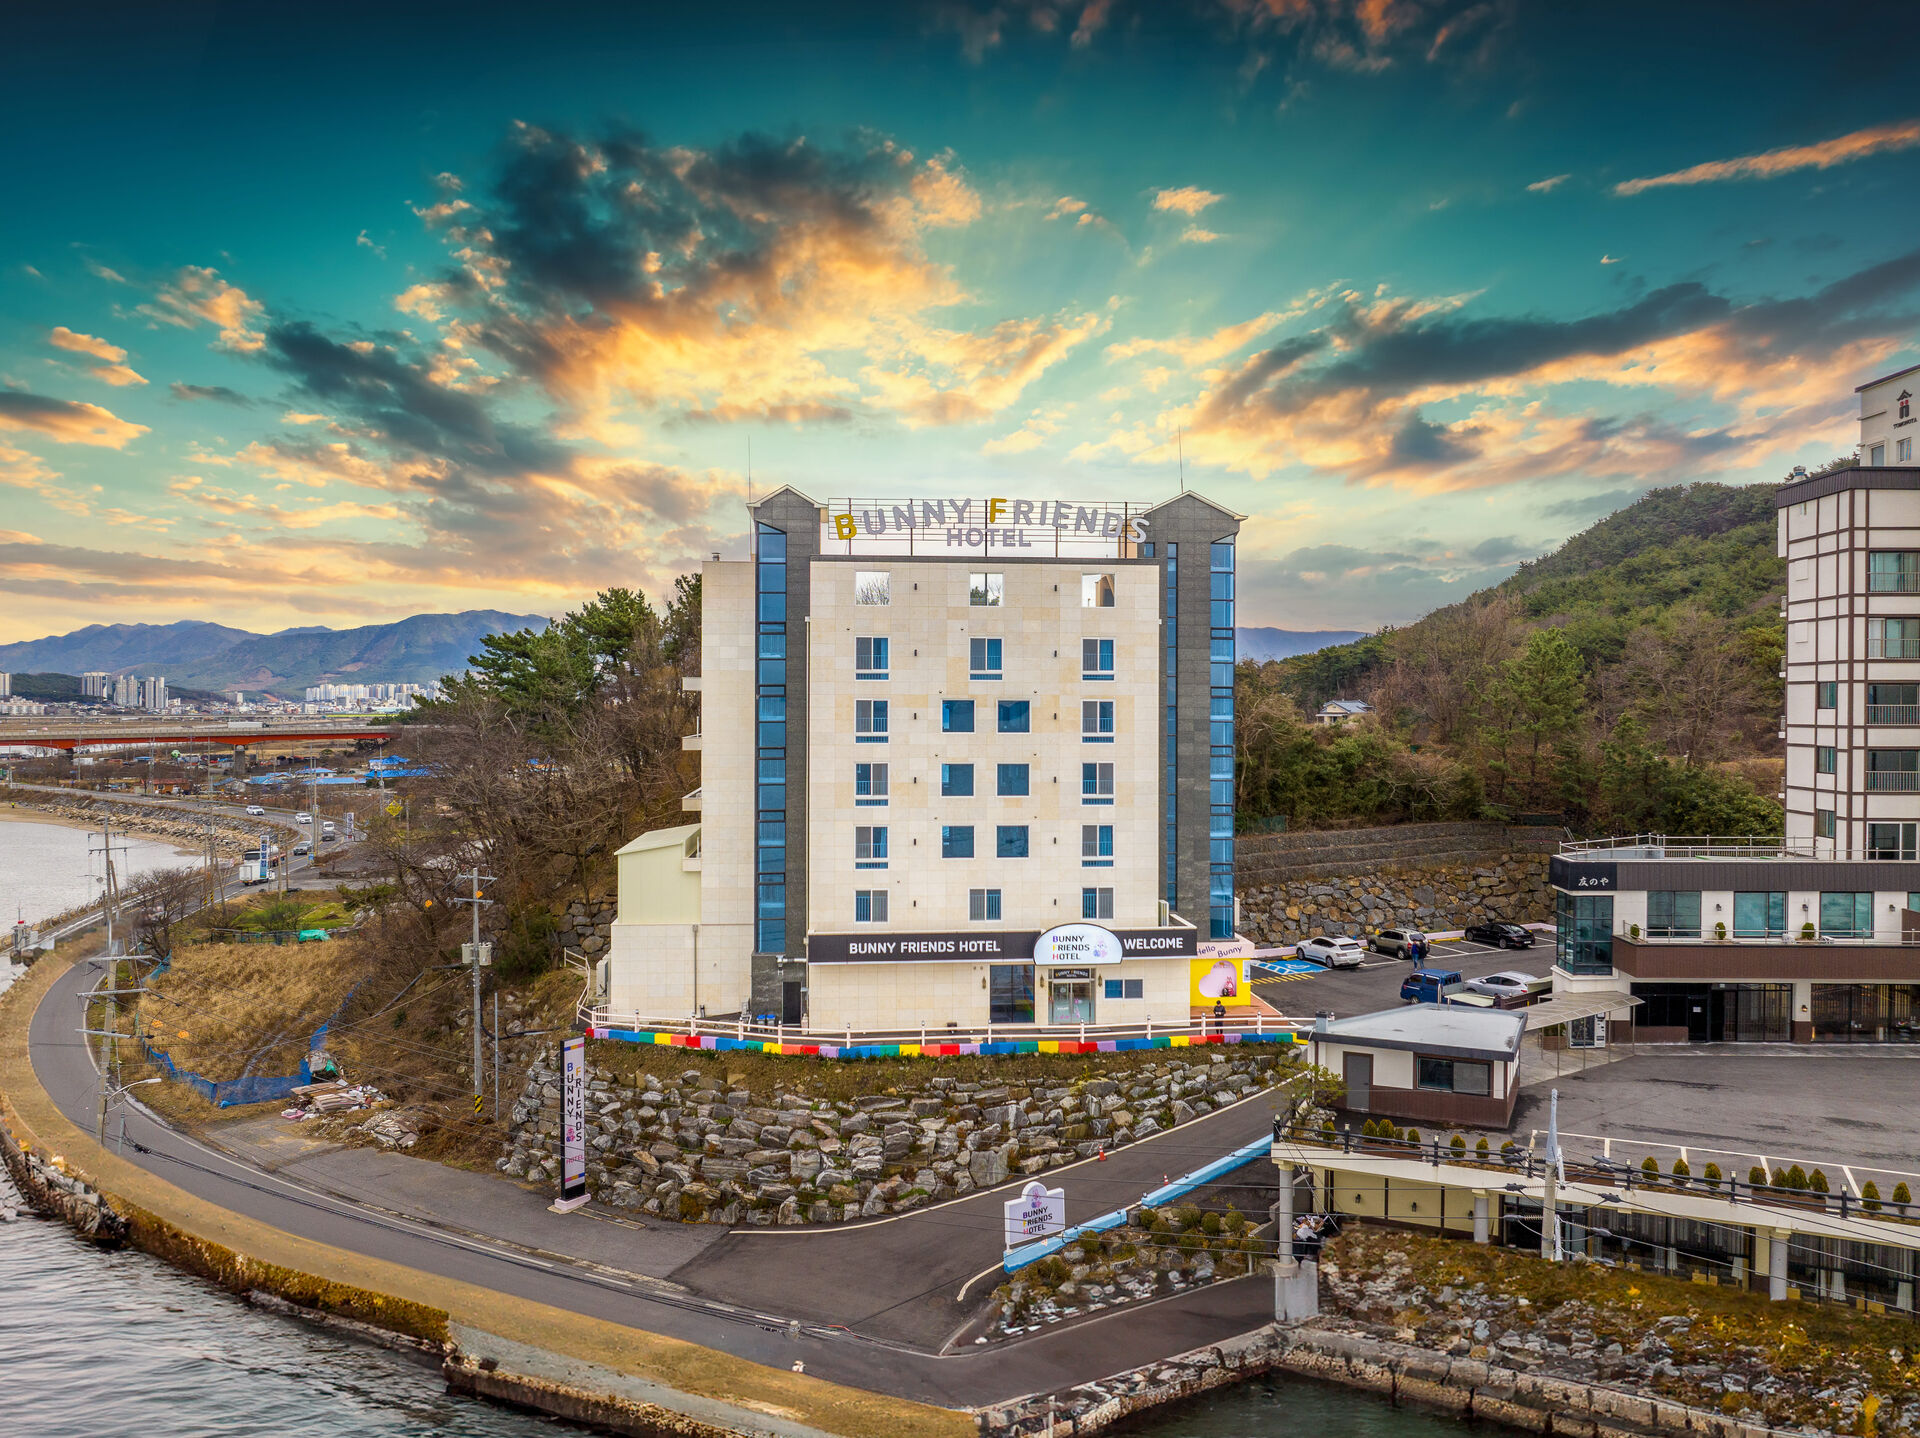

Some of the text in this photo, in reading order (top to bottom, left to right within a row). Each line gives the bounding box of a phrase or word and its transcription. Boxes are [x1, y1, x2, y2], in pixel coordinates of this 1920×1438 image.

[834, 498, 1150, 543] BUNNY FRIENDS
[947, 528, 1032, 547] HOTEL
[1578, 876, 1609, 887] 友のや
[1052, 935, 1085, 943] BUNNY
[1123, 937, 1184, 950] WELCOME
[849, 940, 1001, 954] BUNNY FRIENDS HOTEL
[1217, 946, 1242, 958] Bunny
[566, 1062, 574, 1117] BUNNY
[566, 1154, 584, 1165] HOTEL
[1022, 1206, 1048, 1219] BUNNY
[1023, 1213, 1053, 1228] FRIENDS
[1023, 1224, 1046, 1235] HOTEL
